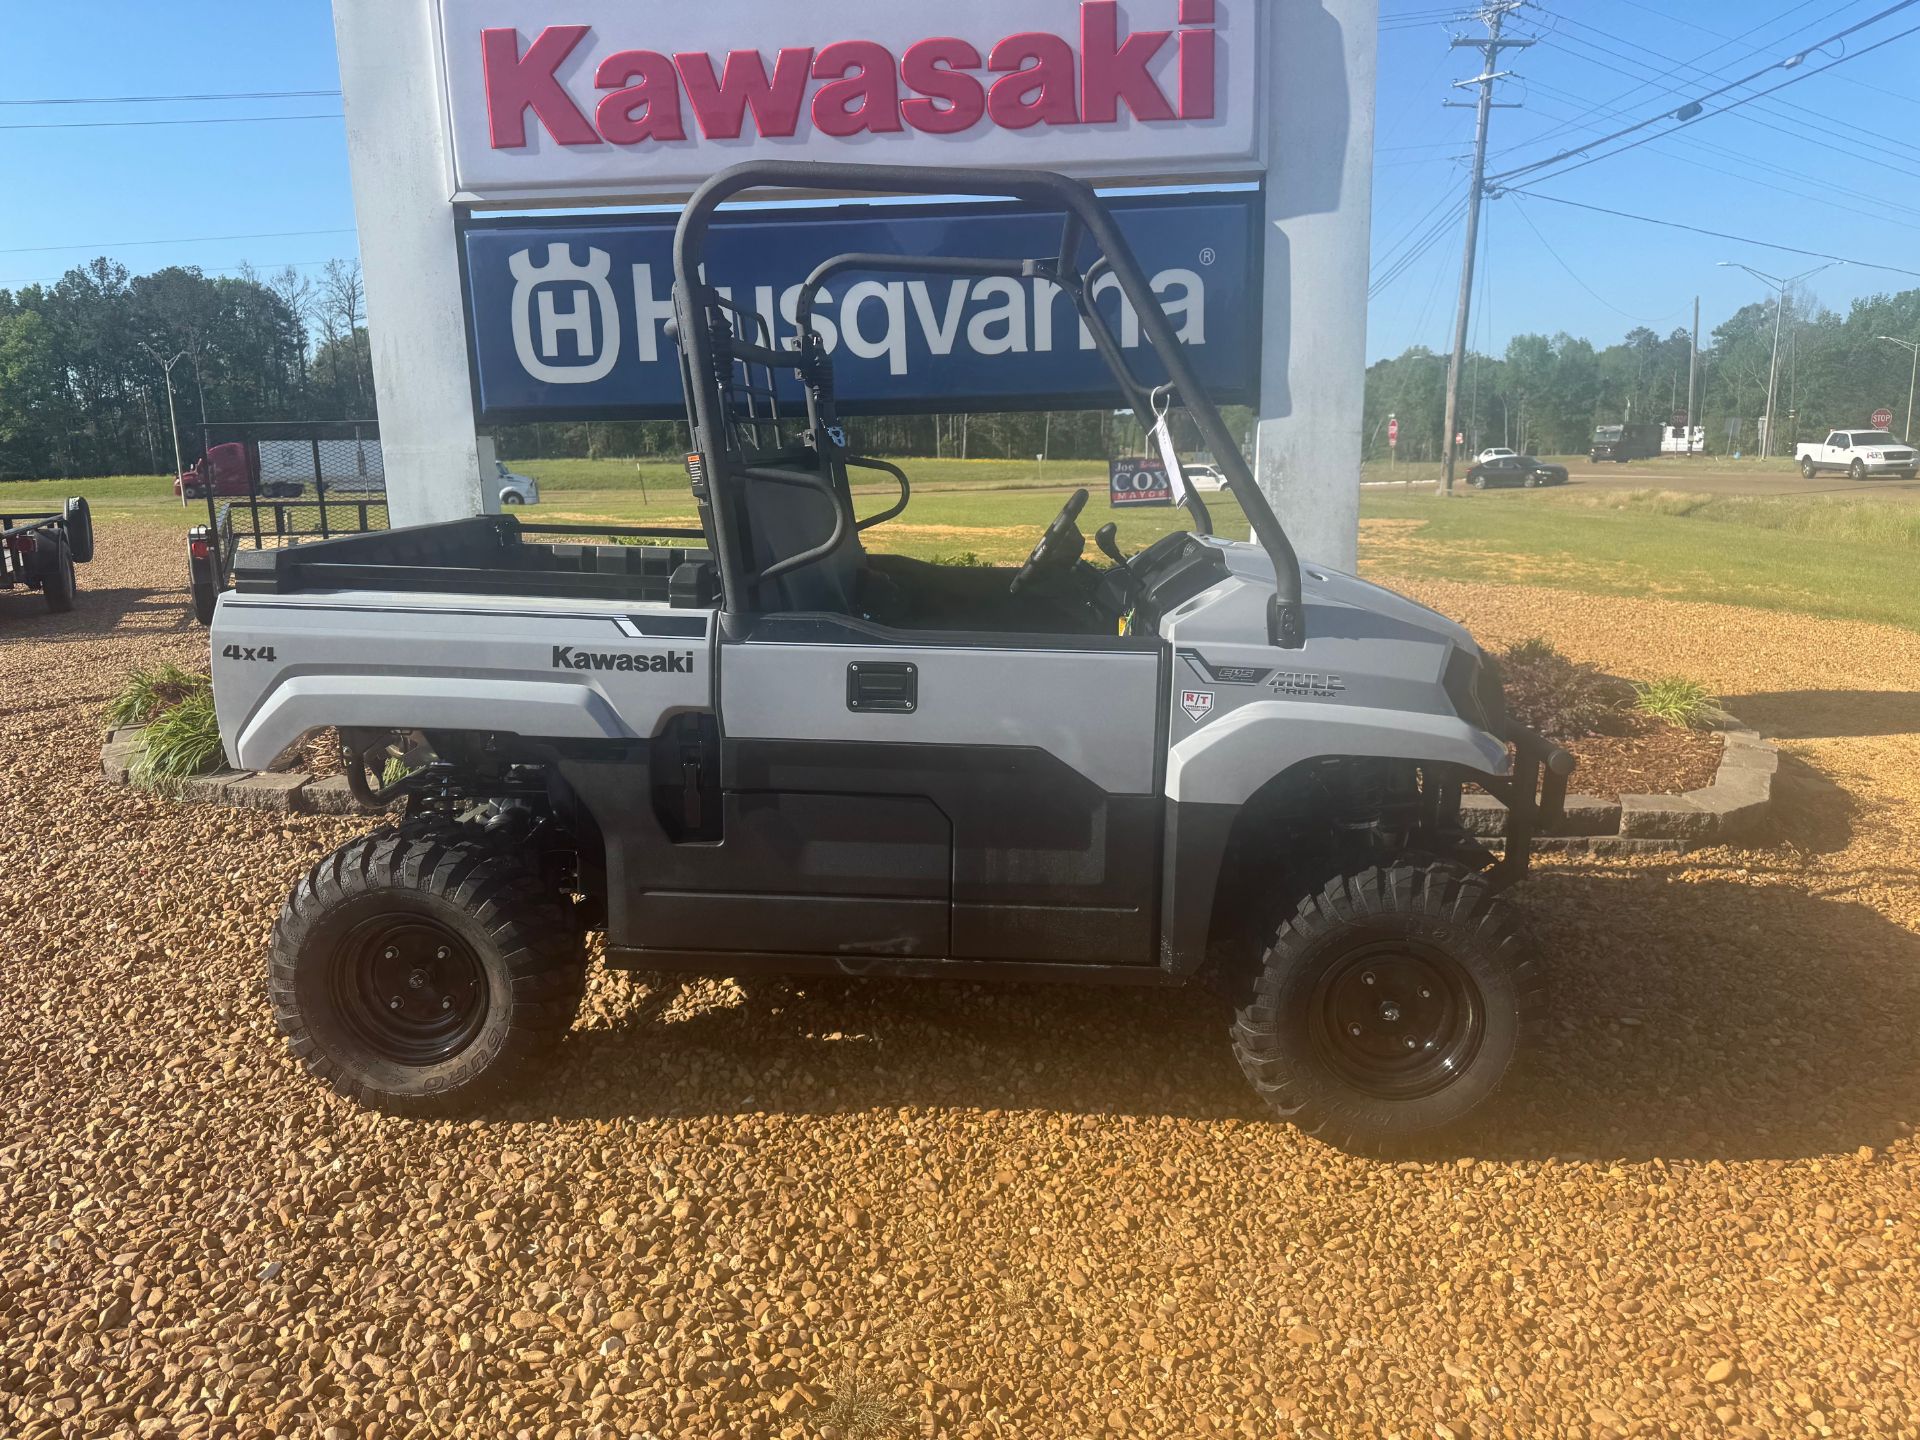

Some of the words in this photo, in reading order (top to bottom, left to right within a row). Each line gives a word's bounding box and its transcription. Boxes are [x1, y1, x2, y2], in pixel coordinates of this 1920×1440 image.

[480, 0, 1218, 149] Kawasaki
[1872, 414, 1891, 422] STOP
[1115, 463, 1134, 471] Joe
[1112, 472, 1168, 491] COX
[1116, 490, 1165, 499] MAYOR
[222, 644, 277, 662] 4x4
[552, 646, 694, 674] Kawasaki
[1265, 671, 1346, 690] MULE
[1185, 693, 1209, 706] R/T
[1273, 687, 1337, 697] PRO-MX
